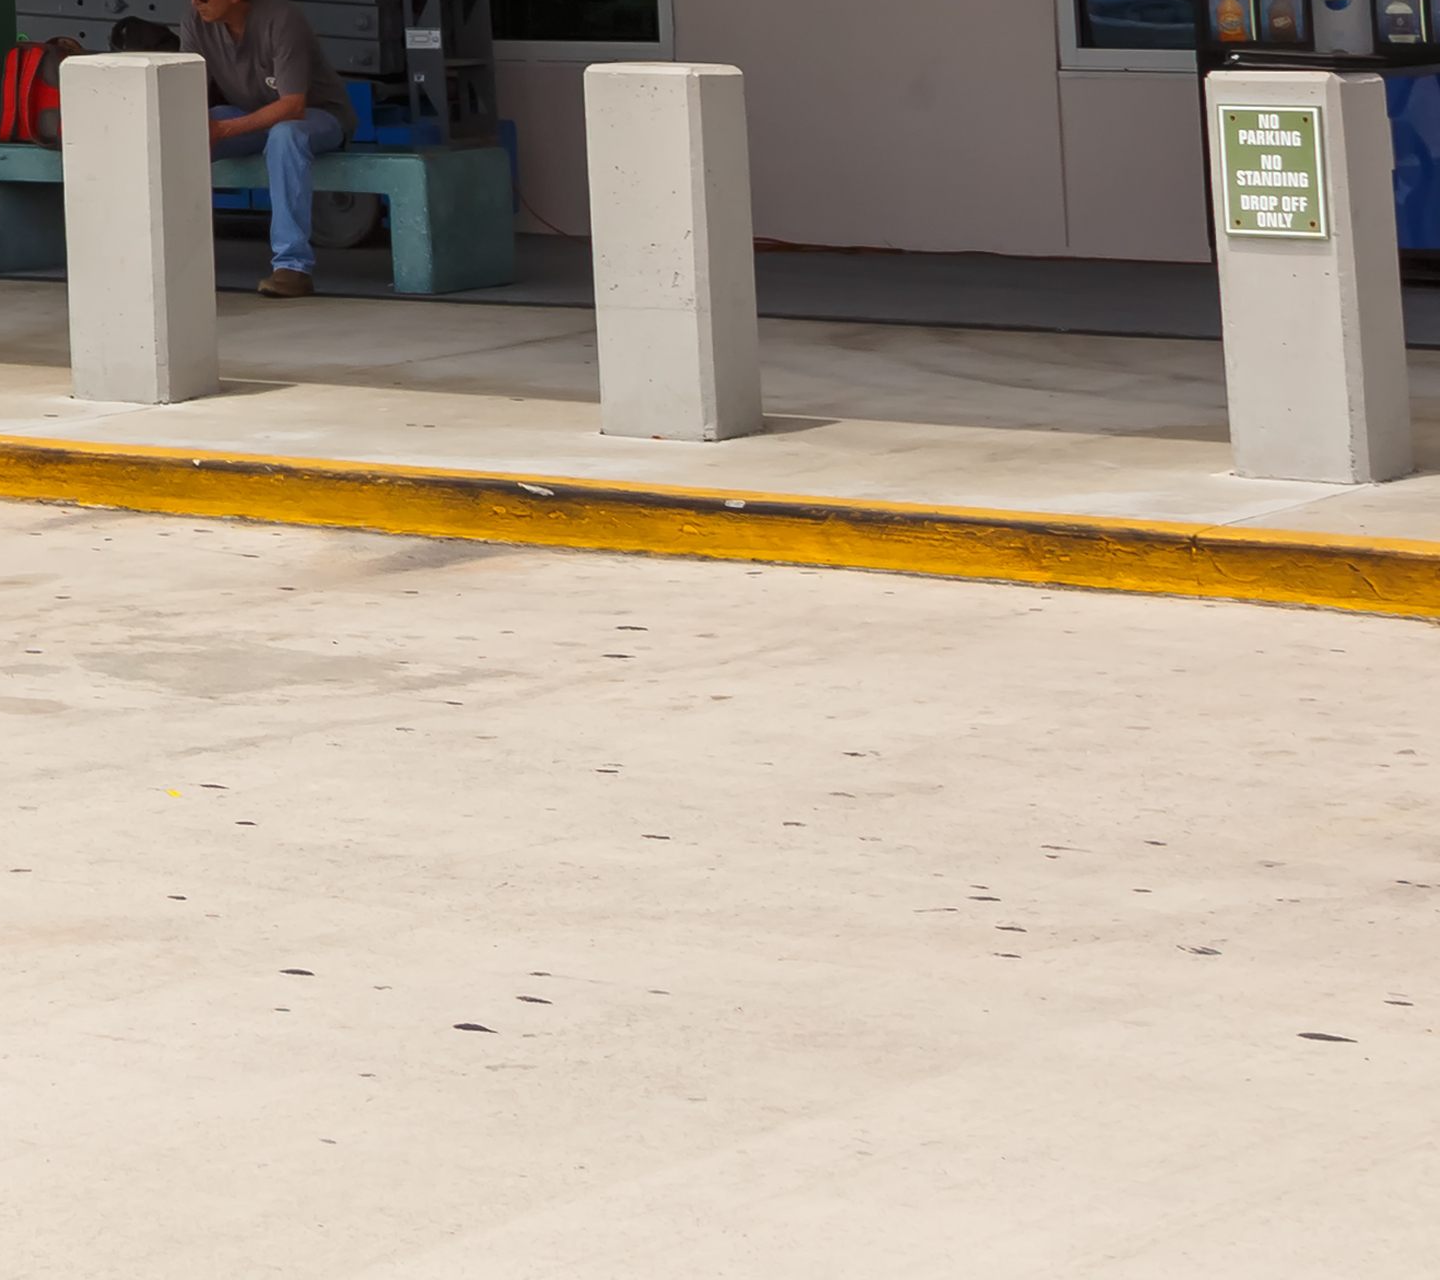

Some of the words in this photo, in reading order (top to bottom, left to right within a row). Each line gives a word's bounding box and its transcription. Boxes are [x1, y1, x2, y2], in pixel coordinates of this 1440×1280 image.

[1258, 113, 1280, 130] NO
[1238, 129, 1302, 147] PARKING
[1260, 154, 1282, 171] NO
[1236, 169, 1309, 189] STANDING
[1240, 194, 1279, 212] DROP
[1281, 195, 1309, 213] OFF
[1256, 211, 1294, 228] ONLY
